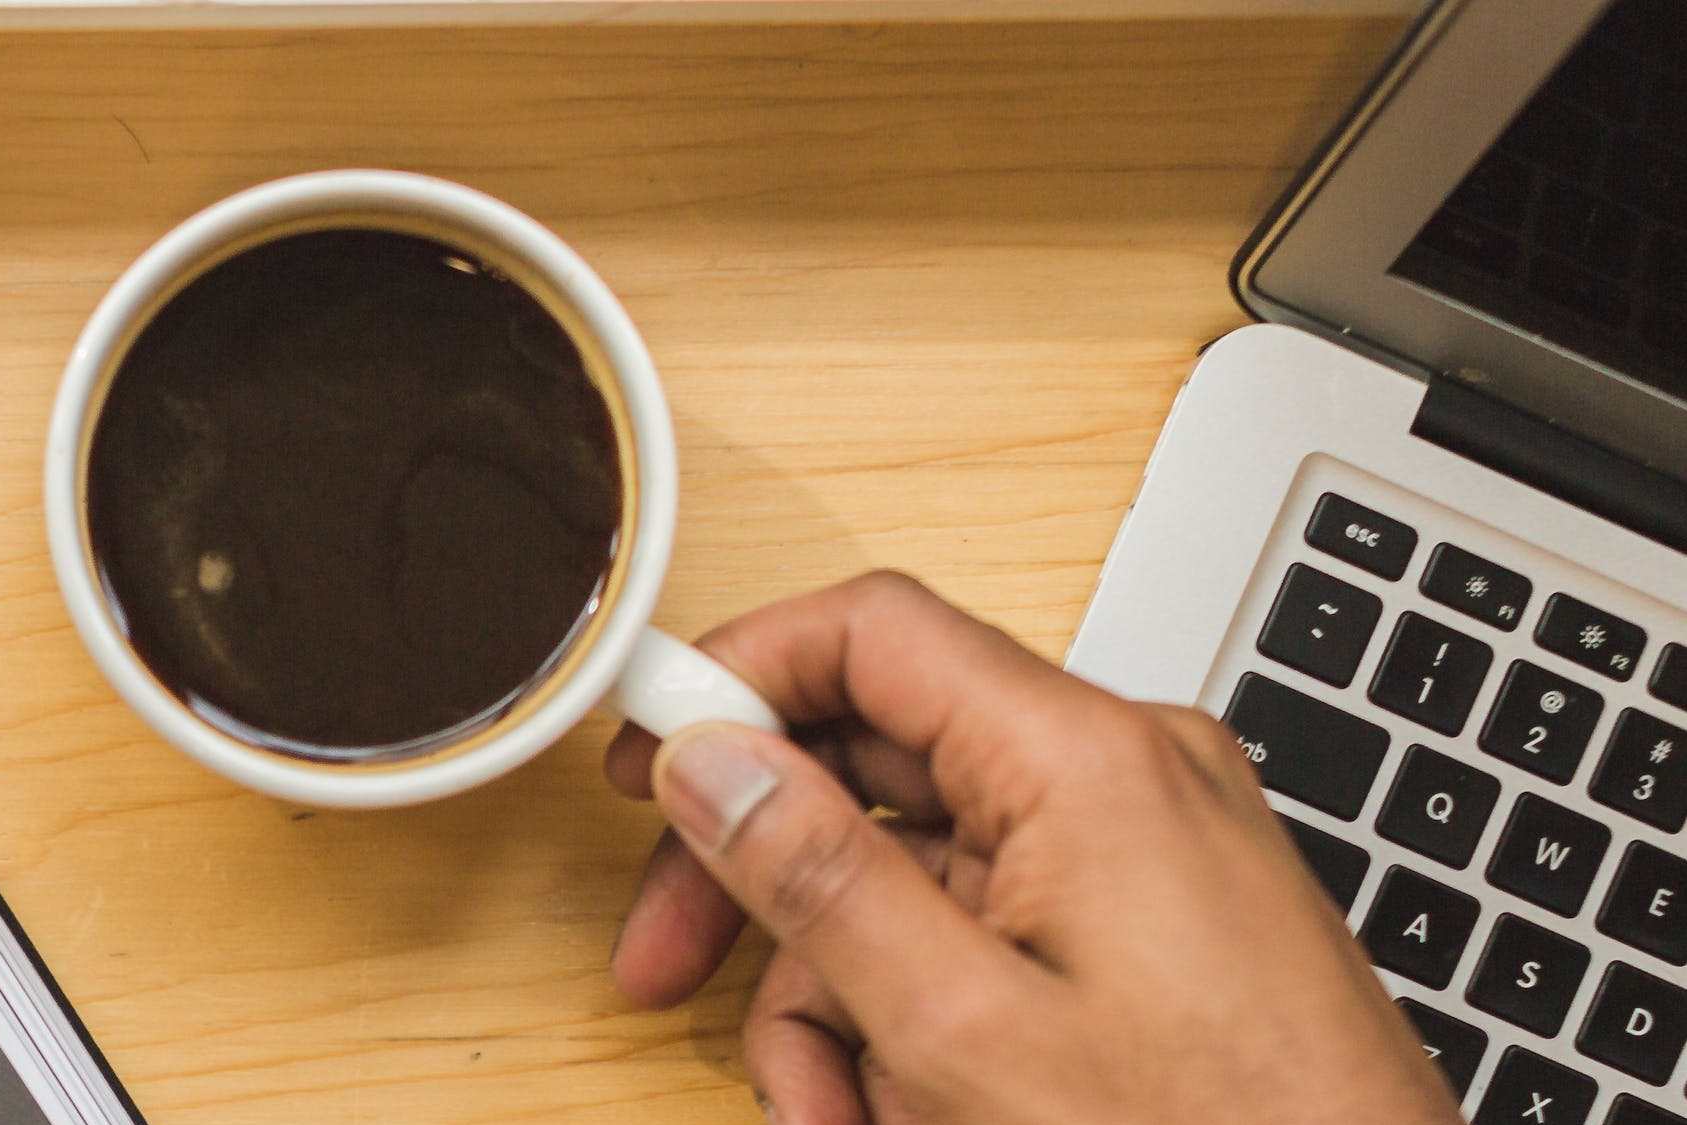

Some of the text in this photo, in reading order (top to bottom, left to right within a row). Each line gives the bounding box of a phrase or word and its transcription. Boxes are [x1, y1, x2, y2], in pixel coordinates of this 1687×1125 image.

[1345, 523, 1381, 548] esc
[1522, 726, 1548, 754] 2
[1632, 774, 1655, 801] 3
[1426, 792, 1454, 824] Q
[1535, 837, 1571, 871] W
[1648, 888, 1674, 917] E
[1402, 913, 1428, 943] A
[1516, 961, 1541, 989] S
[1625, 1007, 1654, 1037] D
[1521, 1092, 1553, 1124] X
